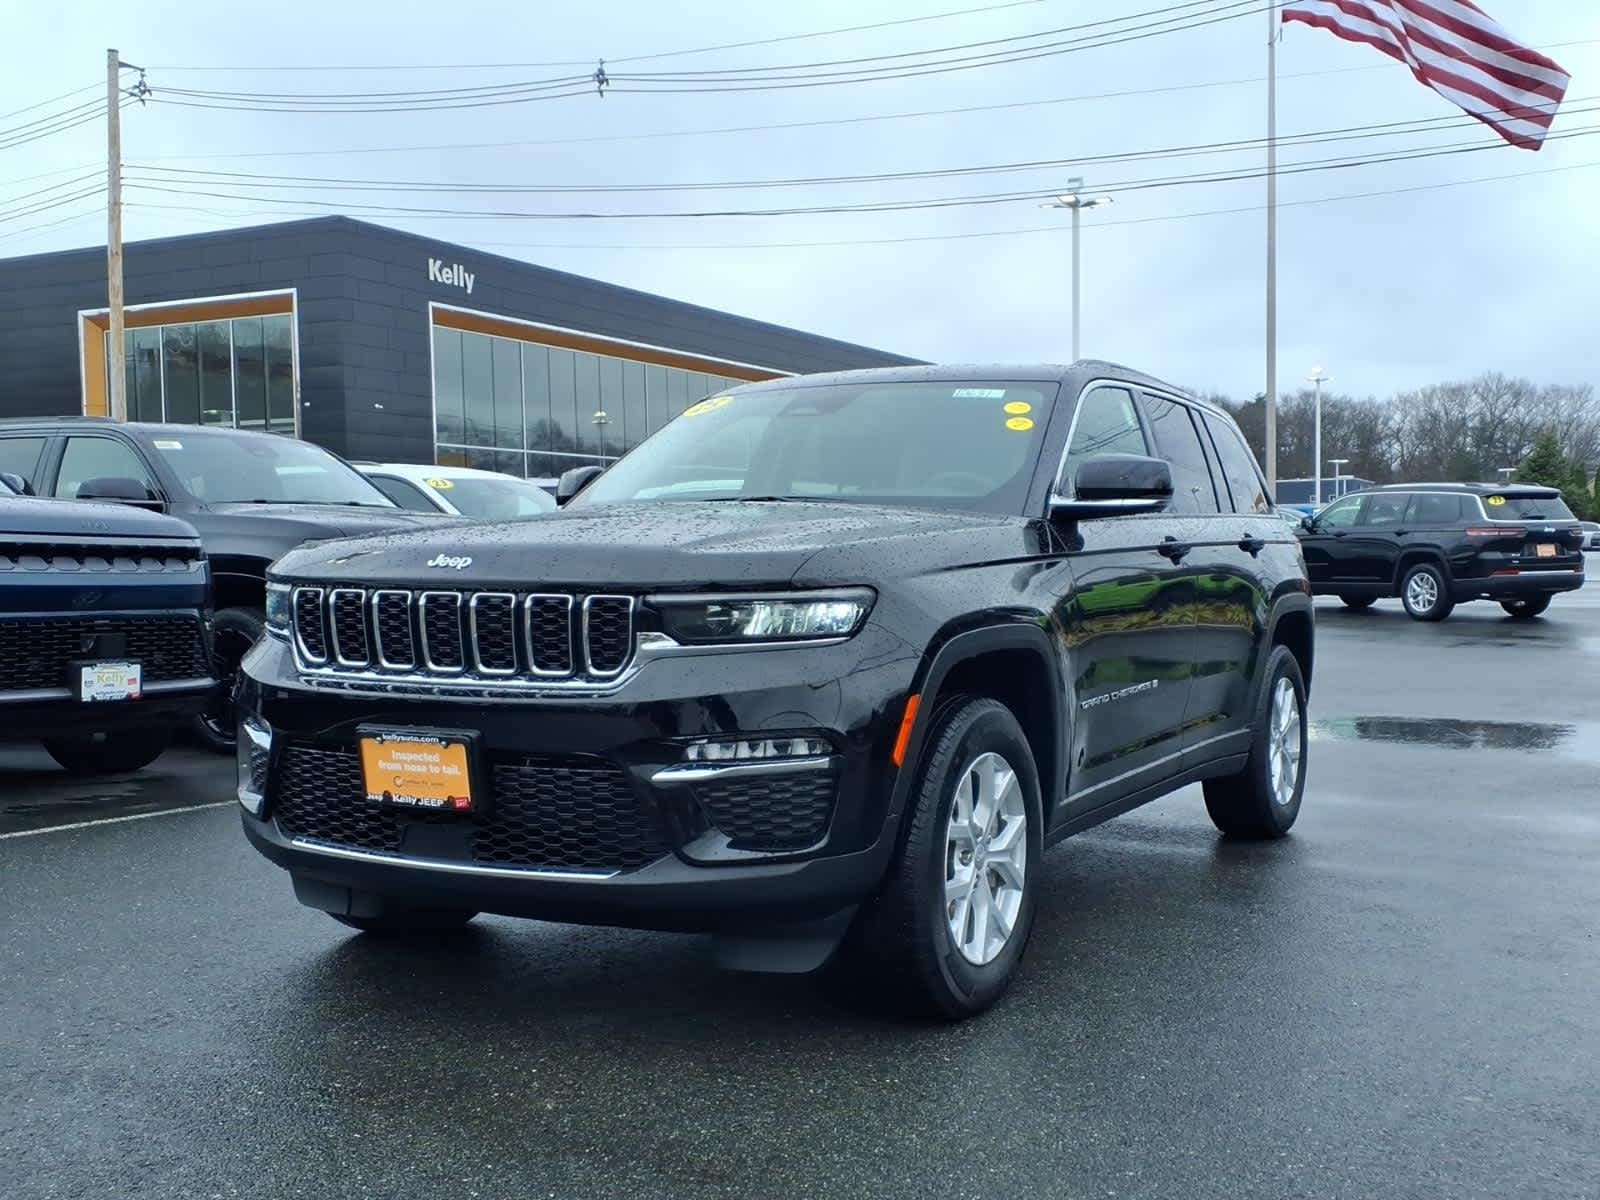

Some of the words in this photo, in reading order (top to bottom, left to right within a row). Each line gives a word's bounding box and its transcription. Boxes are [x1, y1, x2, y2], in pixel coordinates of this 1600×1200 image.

[428, 258, 474, 294] Kelly
[427, 553, 473, 570] Jeep
[96, 671, 125, 685] Kelly
[1081, 694, 1110, 709] GRAND
[1111, 681, 1152, 700] CHEROKEE
[382, 733, 439, 744] kellyauto.com
[392, 750, 441, 763] Inspected
[378, 760, 402, 771] from
[404, 763, 428, 773] nose
[429, 764, 441, 774] to
[391, 793, 417, 805] Kelly
[418, 798, 444, 807] JEEP
